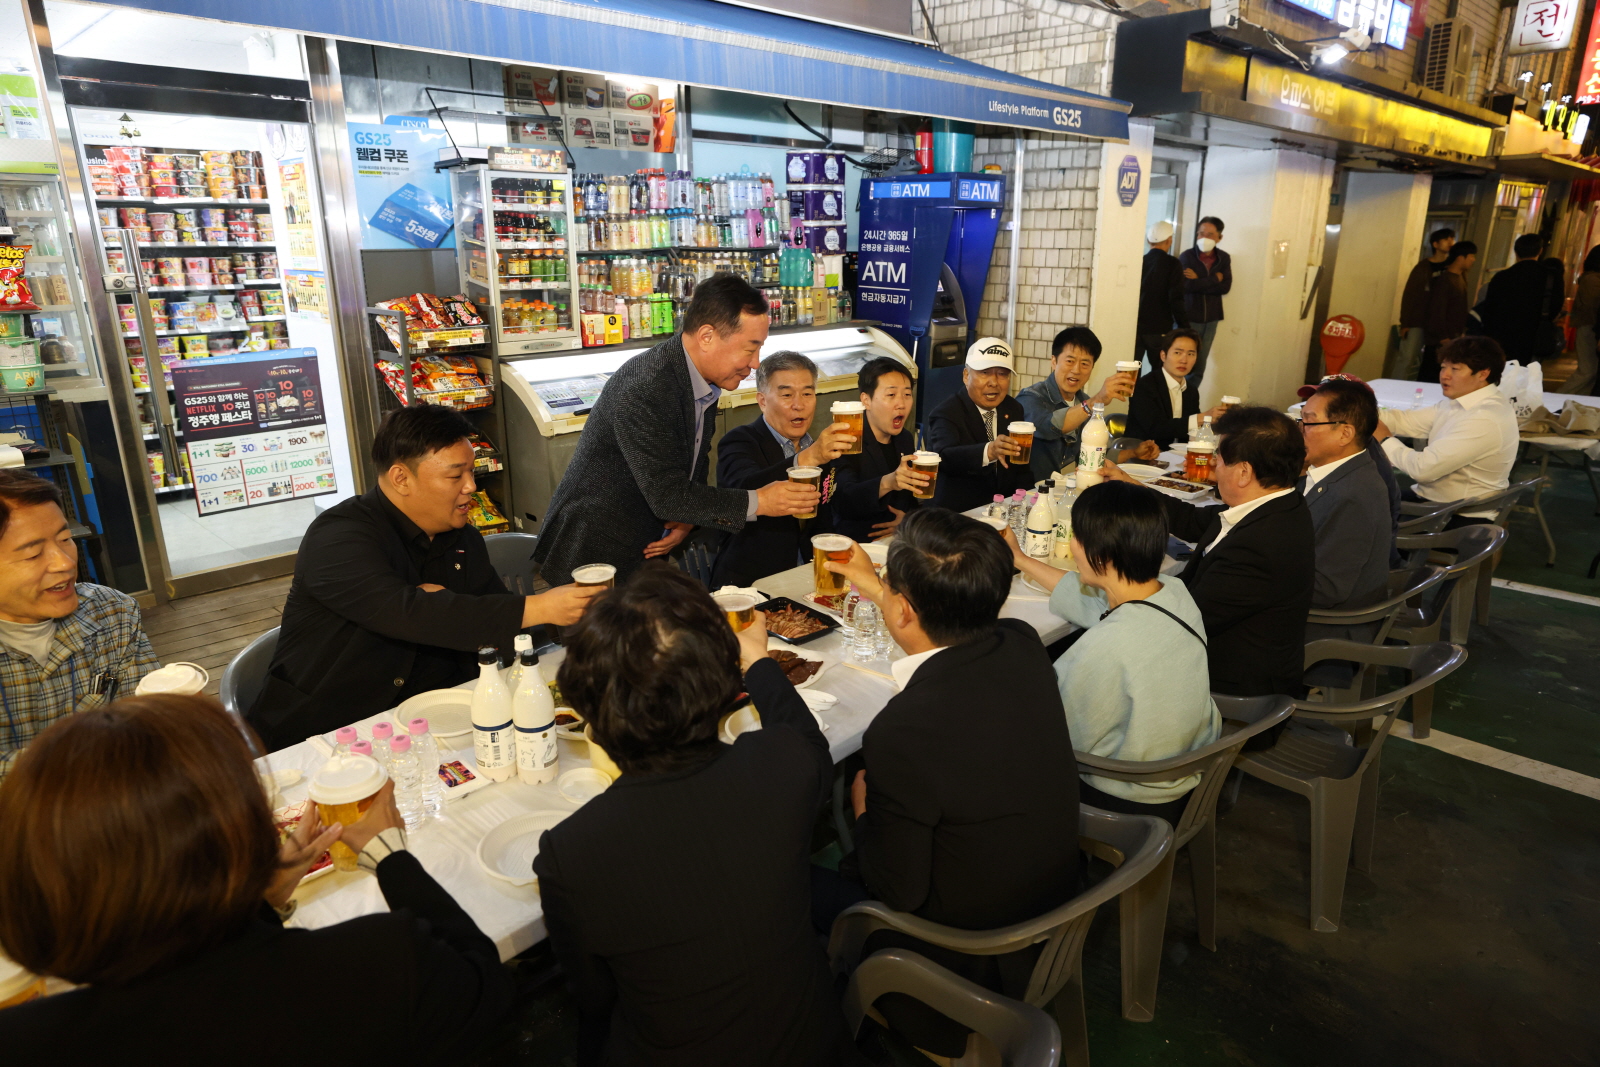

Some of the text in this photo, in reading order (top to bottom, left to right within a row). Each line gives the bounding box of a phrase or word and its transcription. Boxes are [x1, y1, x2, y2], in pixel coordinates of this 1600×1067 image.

[1527, 3, 1560, 38] 전
[988, 101, 1082, 128] Lifestyle Platform GS25
[354, 131, 392, 146] GS25
[356, 147, 408, 163] 웰컴 쿠폰
[1120, 171, 1138, 189] ADT
[902, 183, 930, 197] ATM
[970, 182, 998, 200] ATM
[405, 219, 439, 243] 5천원
[863, 229, 909, 241] 24시간 365일
[883, 244, 911, 253] 금융서비스
[861, 260, 906, 284] ATM
[861, 291, 906, 305] 현금자동지급기
[278, 380, 293, 390] 10
[184, 392, 249, 406] GS25와 함께 하는
[301, 389, 314, 398] 10
[186, 400, 251, 415] NETFLIX 10 주년
[187, 410, 253, 428] 정주행 페스타
[288, 436, 307, 446] 1900
[191, 449, 211, 459] 1+1
[241, 443, 255, 453] 30
[290, 458, 313, 469] 12000
[245, 465, 268, 476] 6000
[196, 473, 218, 484] 700
[295, 482, 314, 491] 2000
[249, 490, 263, 499] 20
[201, 497, 220, 508] 1+1
